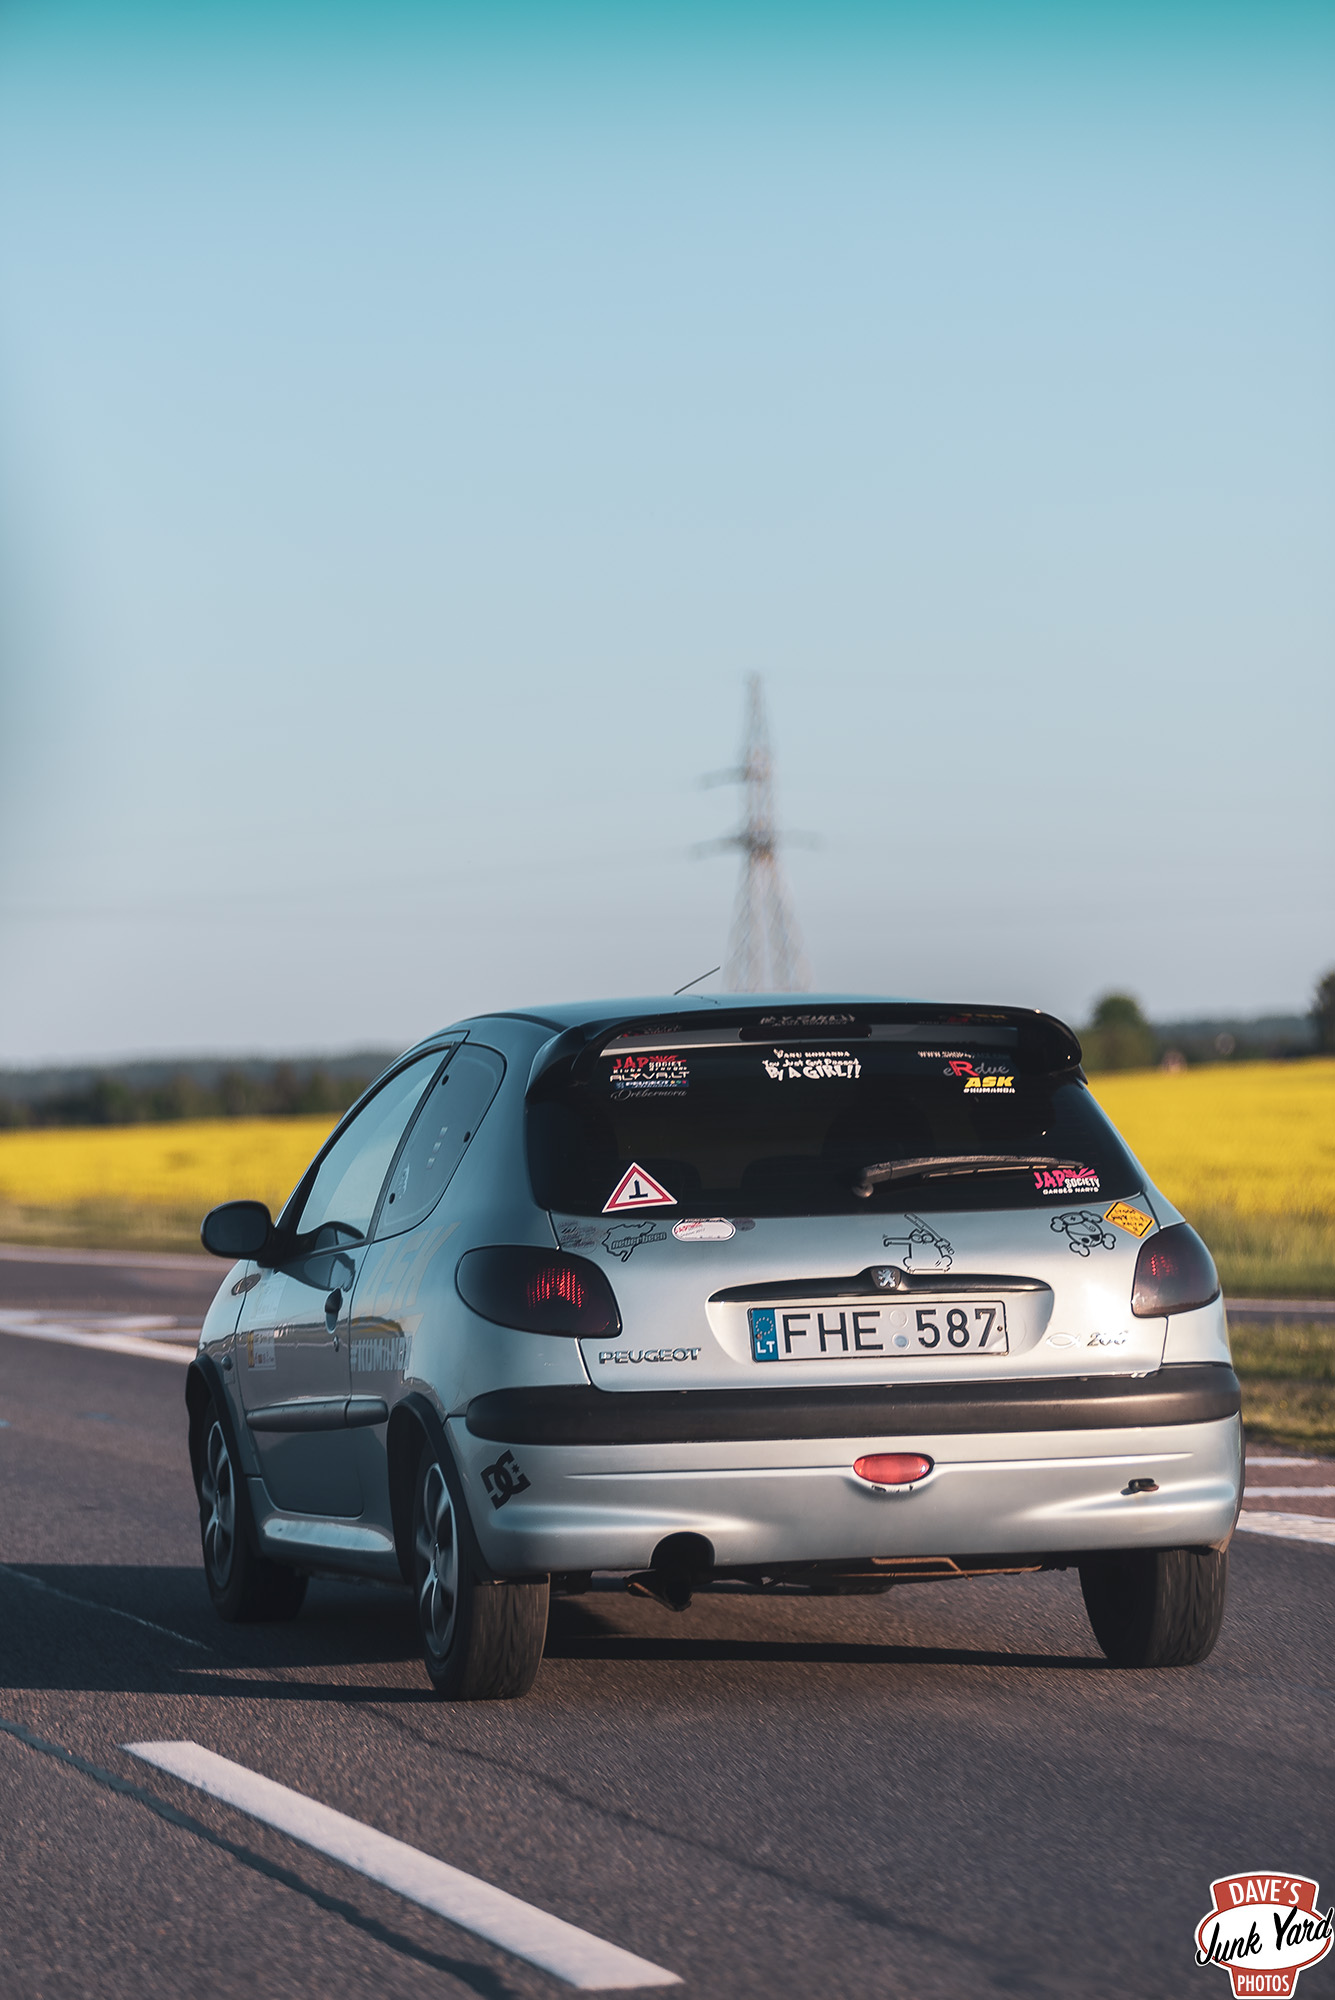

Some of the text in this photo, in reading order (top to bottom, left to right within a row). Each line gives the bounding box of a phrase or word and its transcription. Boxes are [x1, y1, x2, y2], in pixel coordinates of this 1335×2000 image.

[612, 1056, 649, 1069] JAP
[788, 1066, 802, 1079] A
[802, 1064, 862, 1079] GIRL!!
[965, 1076, 1015, 1088] ASK
[1033, 1170, 1065, 1190] JAP
[1064, 1177, 1100, 1188] SOCIETY
[782, 1308, 996, 1353] FHE 587
[756, 1341, 776, 1354] LT
[598, 1347, 701, 1365] PEUGEOT
